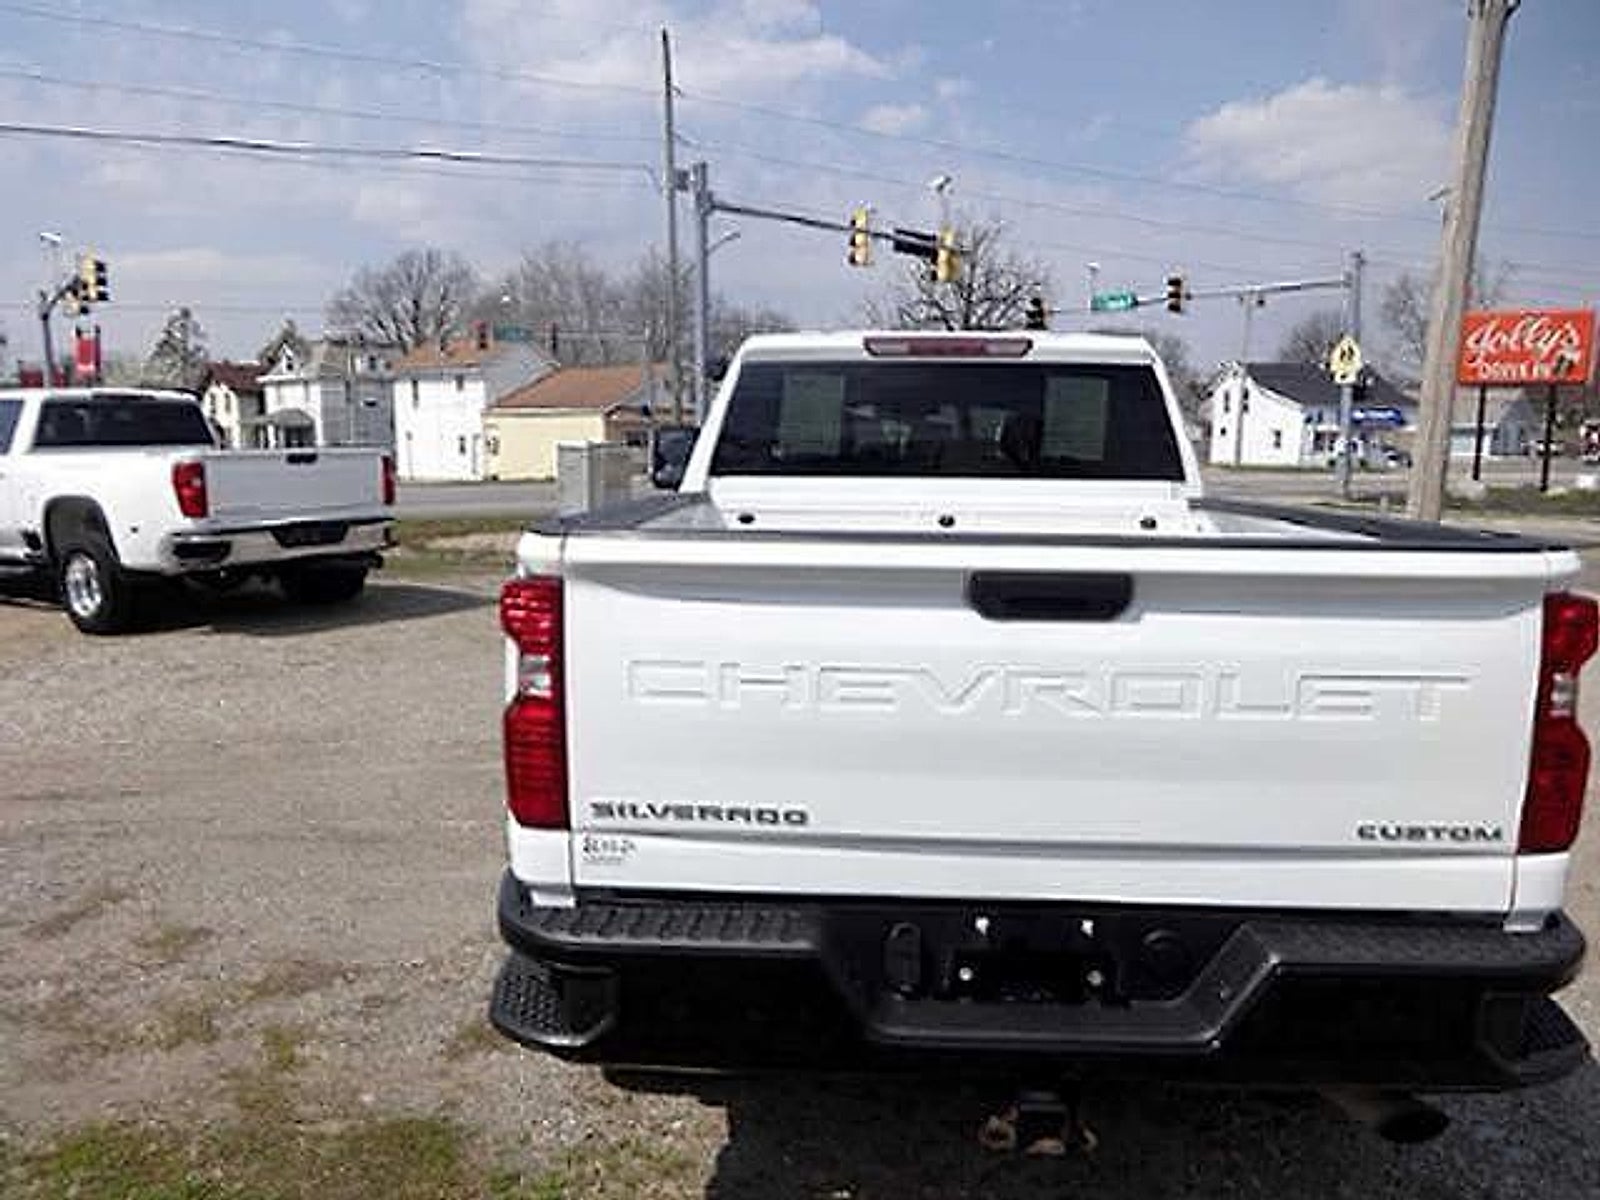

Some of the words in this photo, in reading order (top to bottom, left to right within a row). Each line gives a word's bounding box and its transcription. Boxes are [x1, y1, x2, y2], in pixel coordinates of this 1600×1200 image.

[622, 658, 1475, 721] CHEVROLET
[590, 801, 809, 826] SILVERADO
[1357, 824, 1503, 842] CUSTOM
